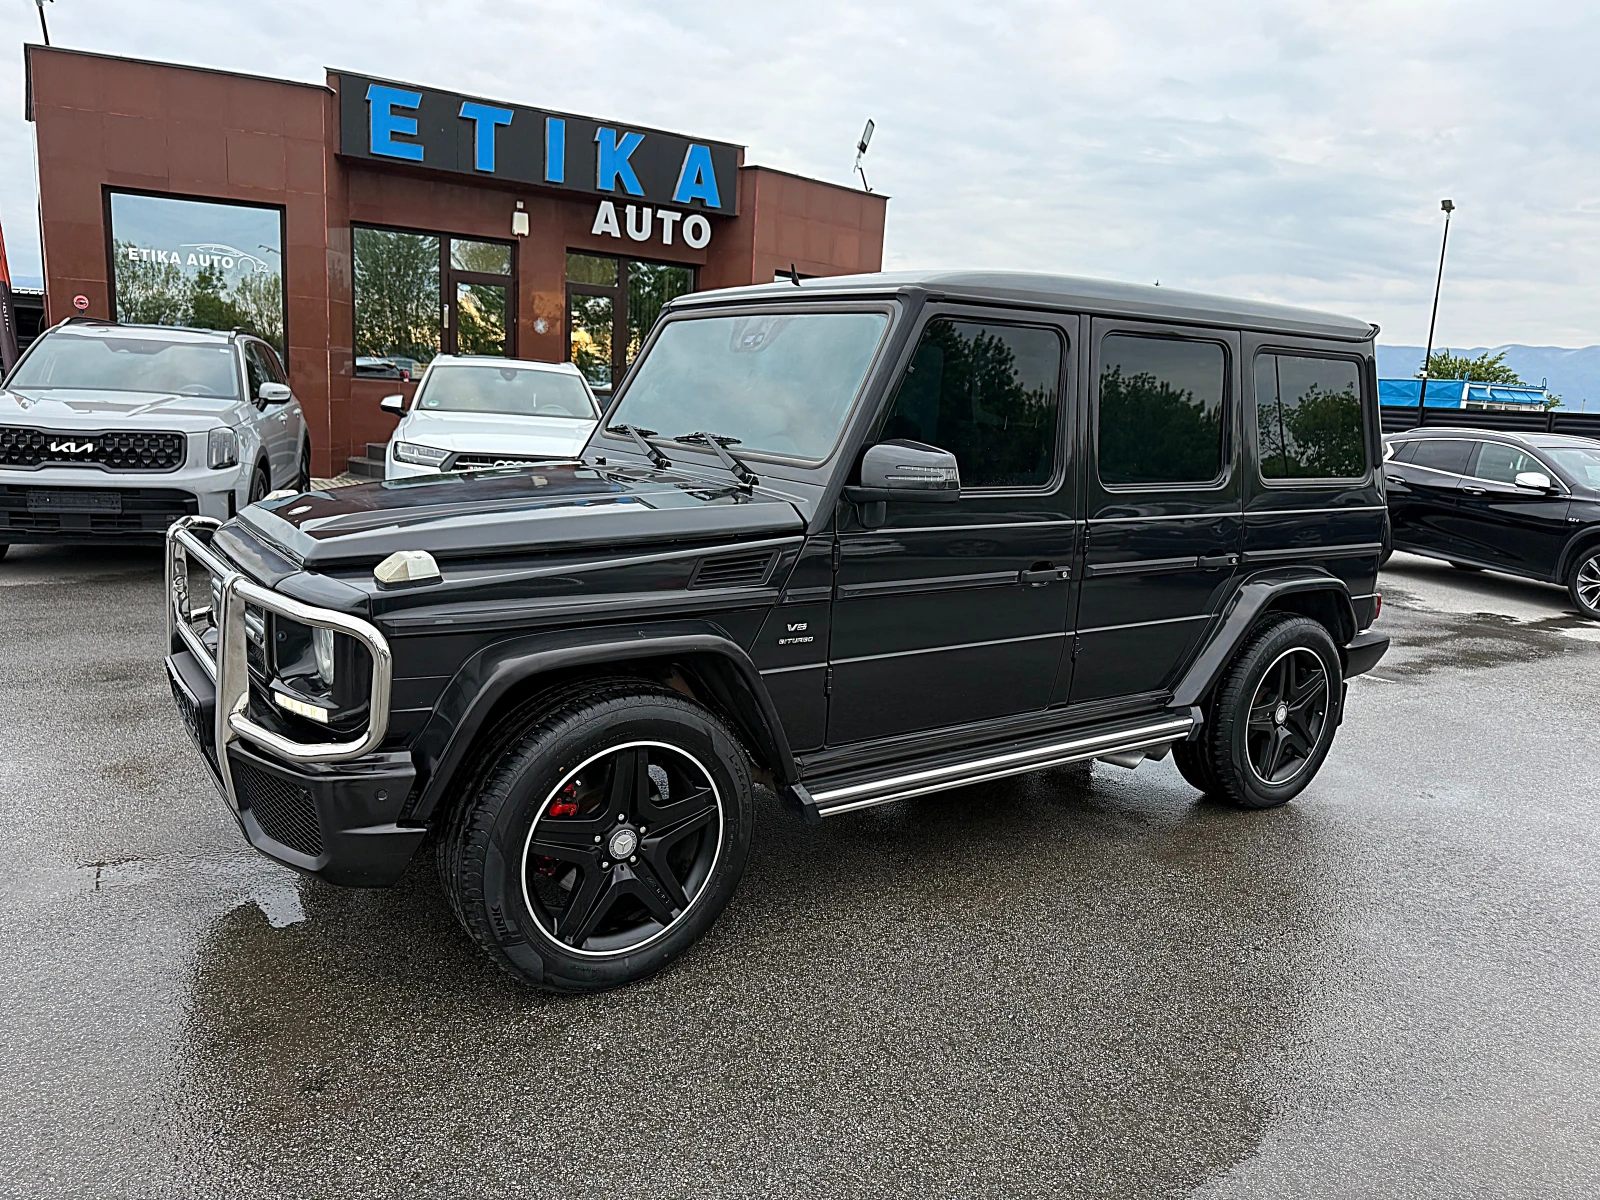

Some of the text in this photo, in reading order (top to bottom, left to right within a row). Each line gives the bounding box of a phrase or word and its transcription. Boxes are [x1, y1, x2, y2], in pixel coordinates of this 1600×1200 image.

[365, 83, 722, 208] ETIKA
[591, 200, 712, 249] AUTO
[128, 247, 234, 269] ETIKA AUTO
[787, 622, 807, 631] V8
